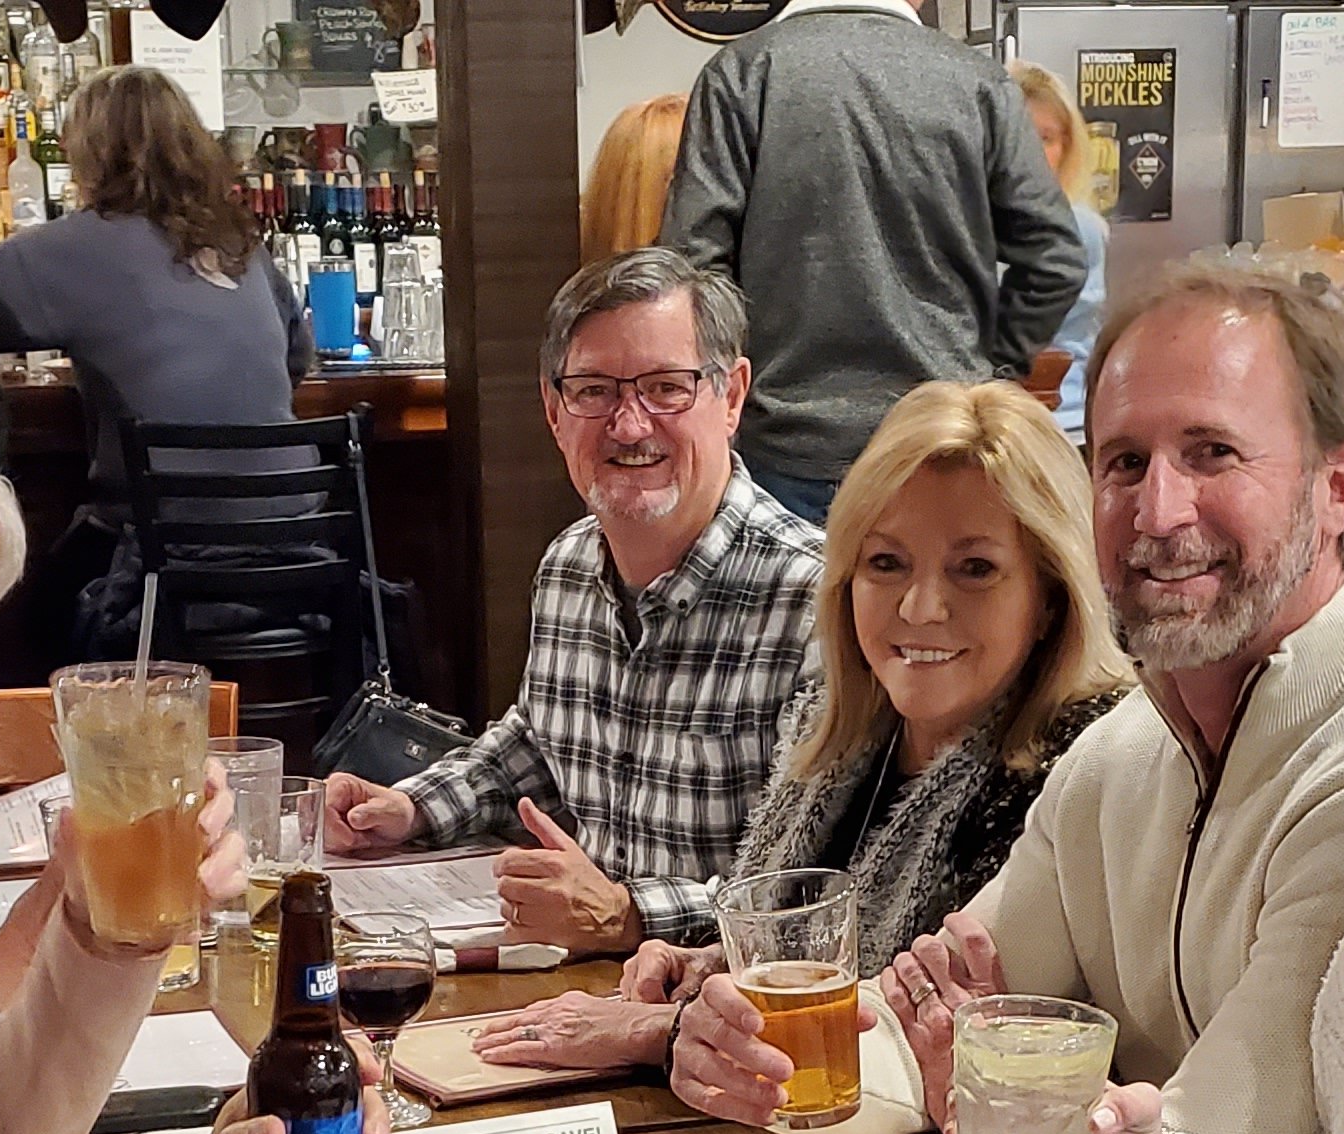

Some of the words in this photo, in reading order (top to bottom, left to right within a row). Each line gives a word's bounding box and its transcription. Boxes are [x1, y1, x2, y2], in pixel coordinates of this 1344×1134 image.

[1080, 62, 1173, 82] MOONSHINE
[1080, 81, 1163, 107] PICKLES
[316, 965, 338, 983] BU
